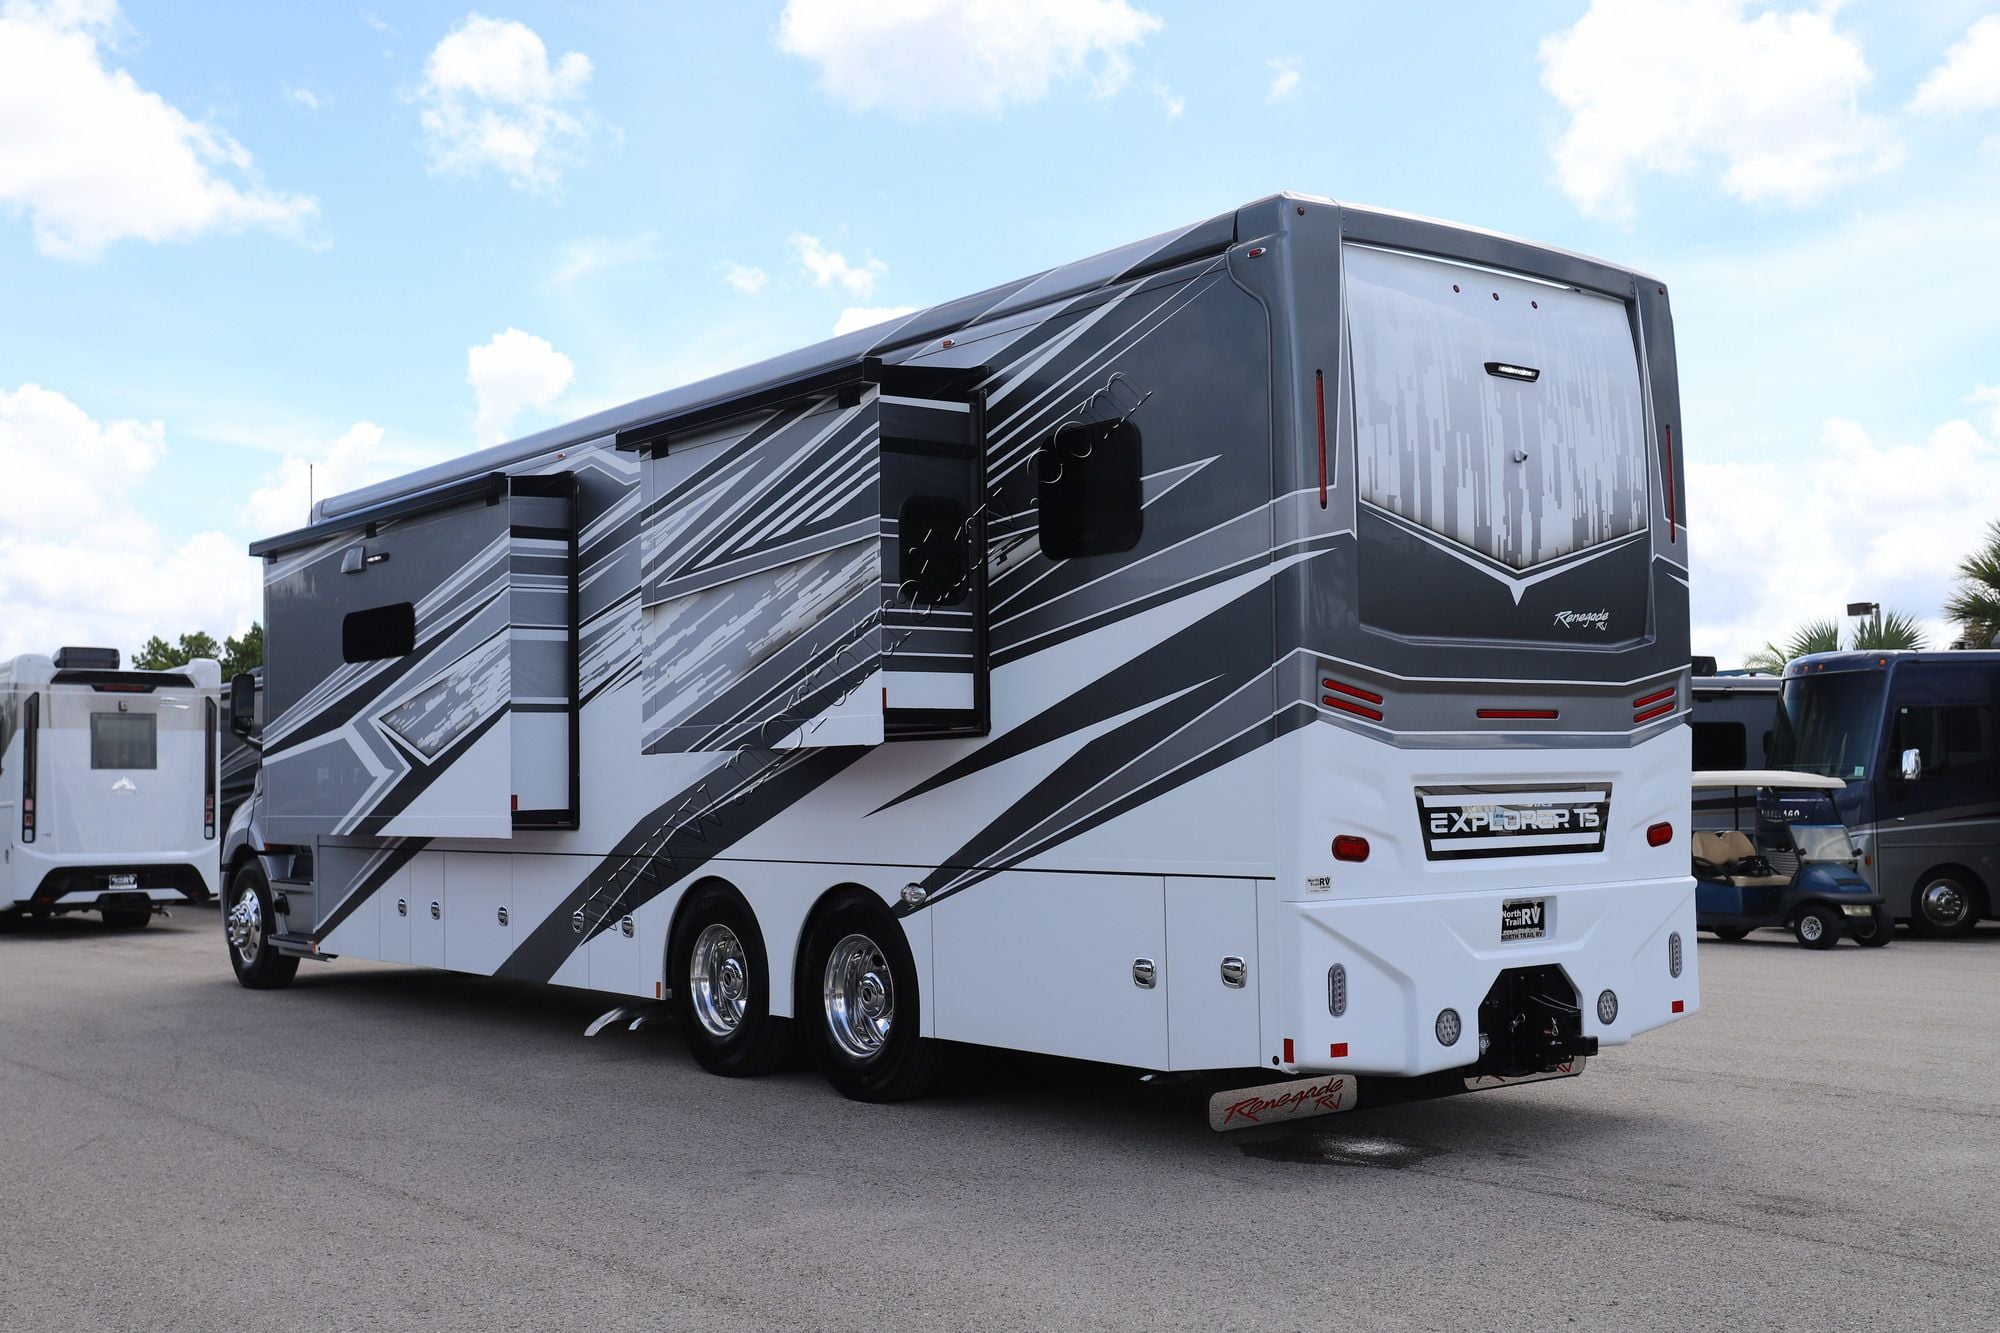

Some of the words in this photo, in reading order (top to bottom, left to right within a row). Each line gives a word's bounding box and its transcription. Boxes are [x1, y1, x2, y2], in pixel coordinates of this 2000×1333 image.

[1553, 608, 1609, 629] Renegade
[1595, 621, 1608, 631] RV
[1430, 809, 1570, 834] EXPLORER
[1319, 876, 1331, 886] RV
[1503, 909, 1522, 918] North
[1505, 917, 1522, 927] Trail
[1521, 905, 1541, 925] RV
[1223, 1077, 1344, 1125] Renegade
[1314, 1093, 1342, 1110] RV
